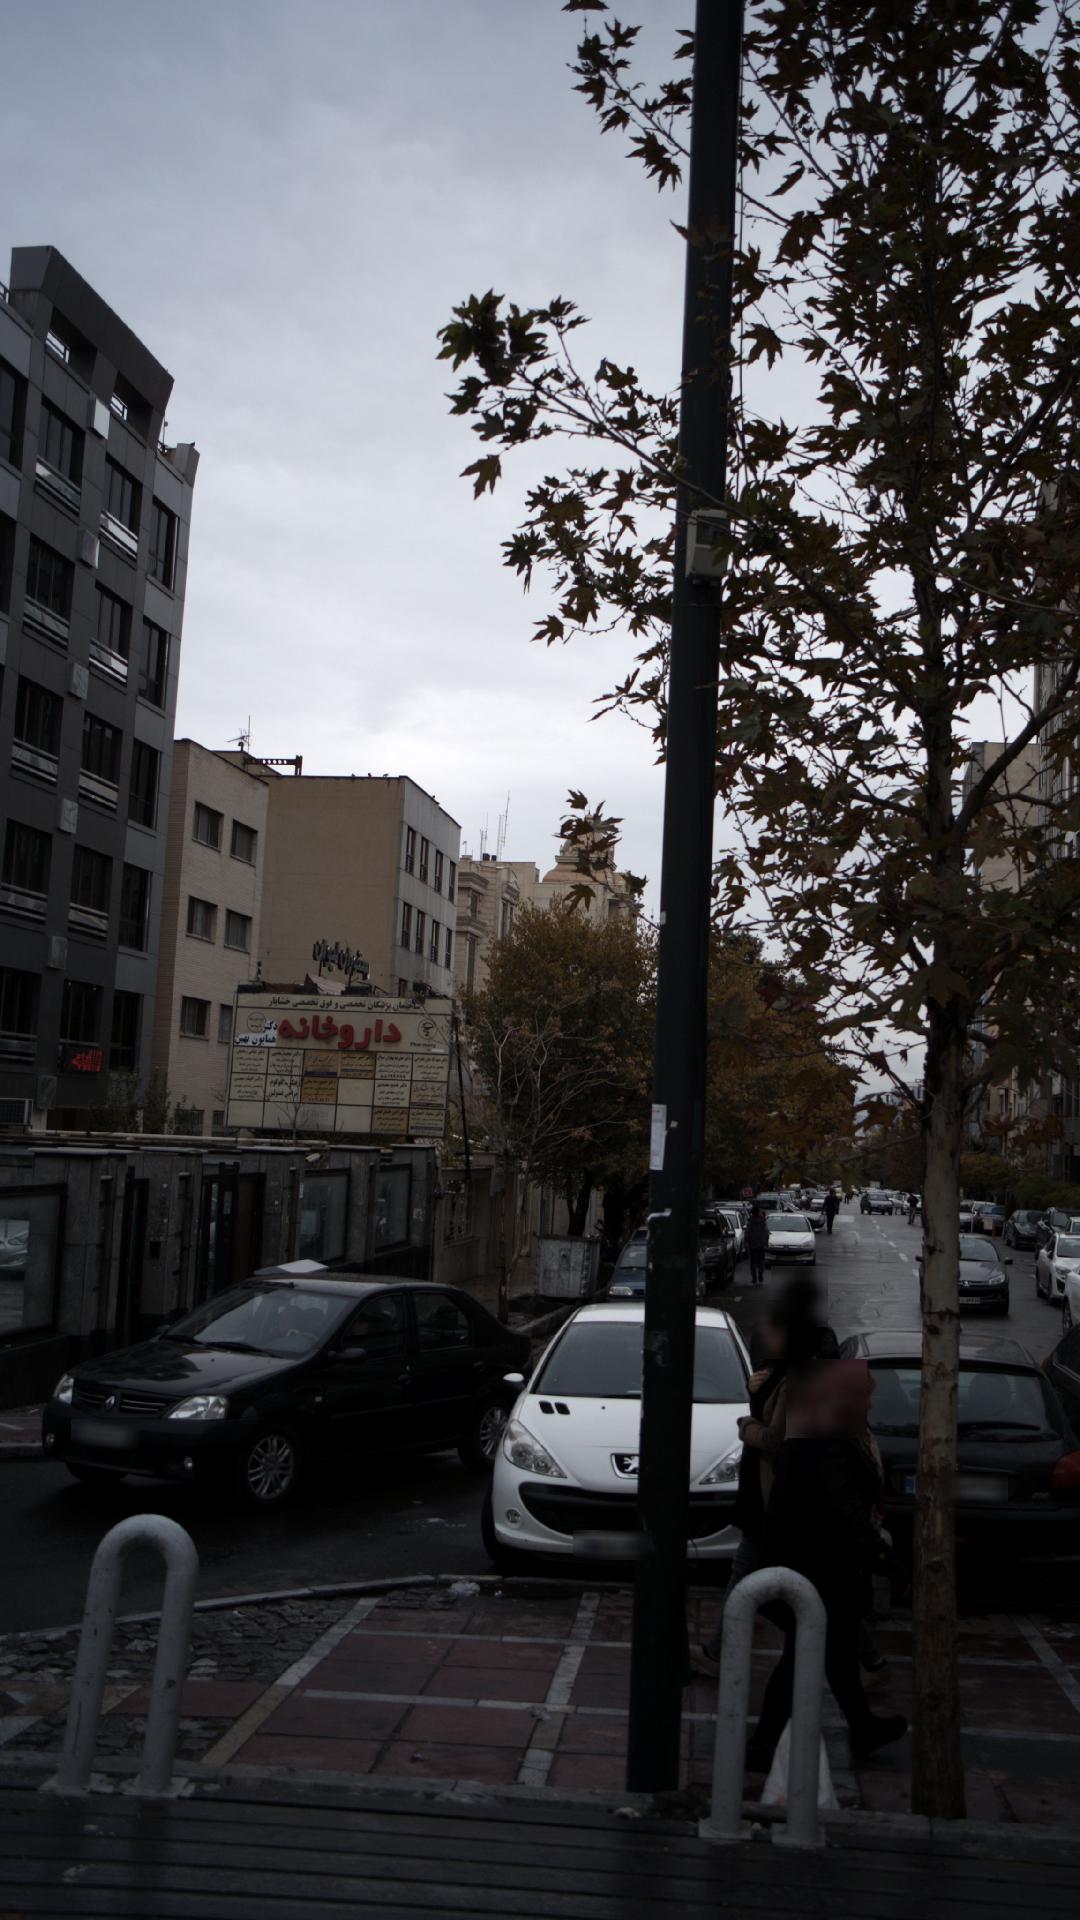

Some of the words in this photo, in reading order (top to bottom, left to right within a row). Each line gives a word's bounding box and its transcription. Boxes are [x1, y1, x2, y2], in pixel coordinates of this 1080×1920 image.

[293, 998, 319, 1008] تخصصی
[320, 999, 332, 1008] فوق
[340, 999, 366, 1009] تخصصی
[368, 1000, 391, 1011] پزشکان
[263, 1020, 277, 1033] دکتر
[279, 1015, 401, 1050] داروخانه
[252, 1034, 276, 1046] همایون
